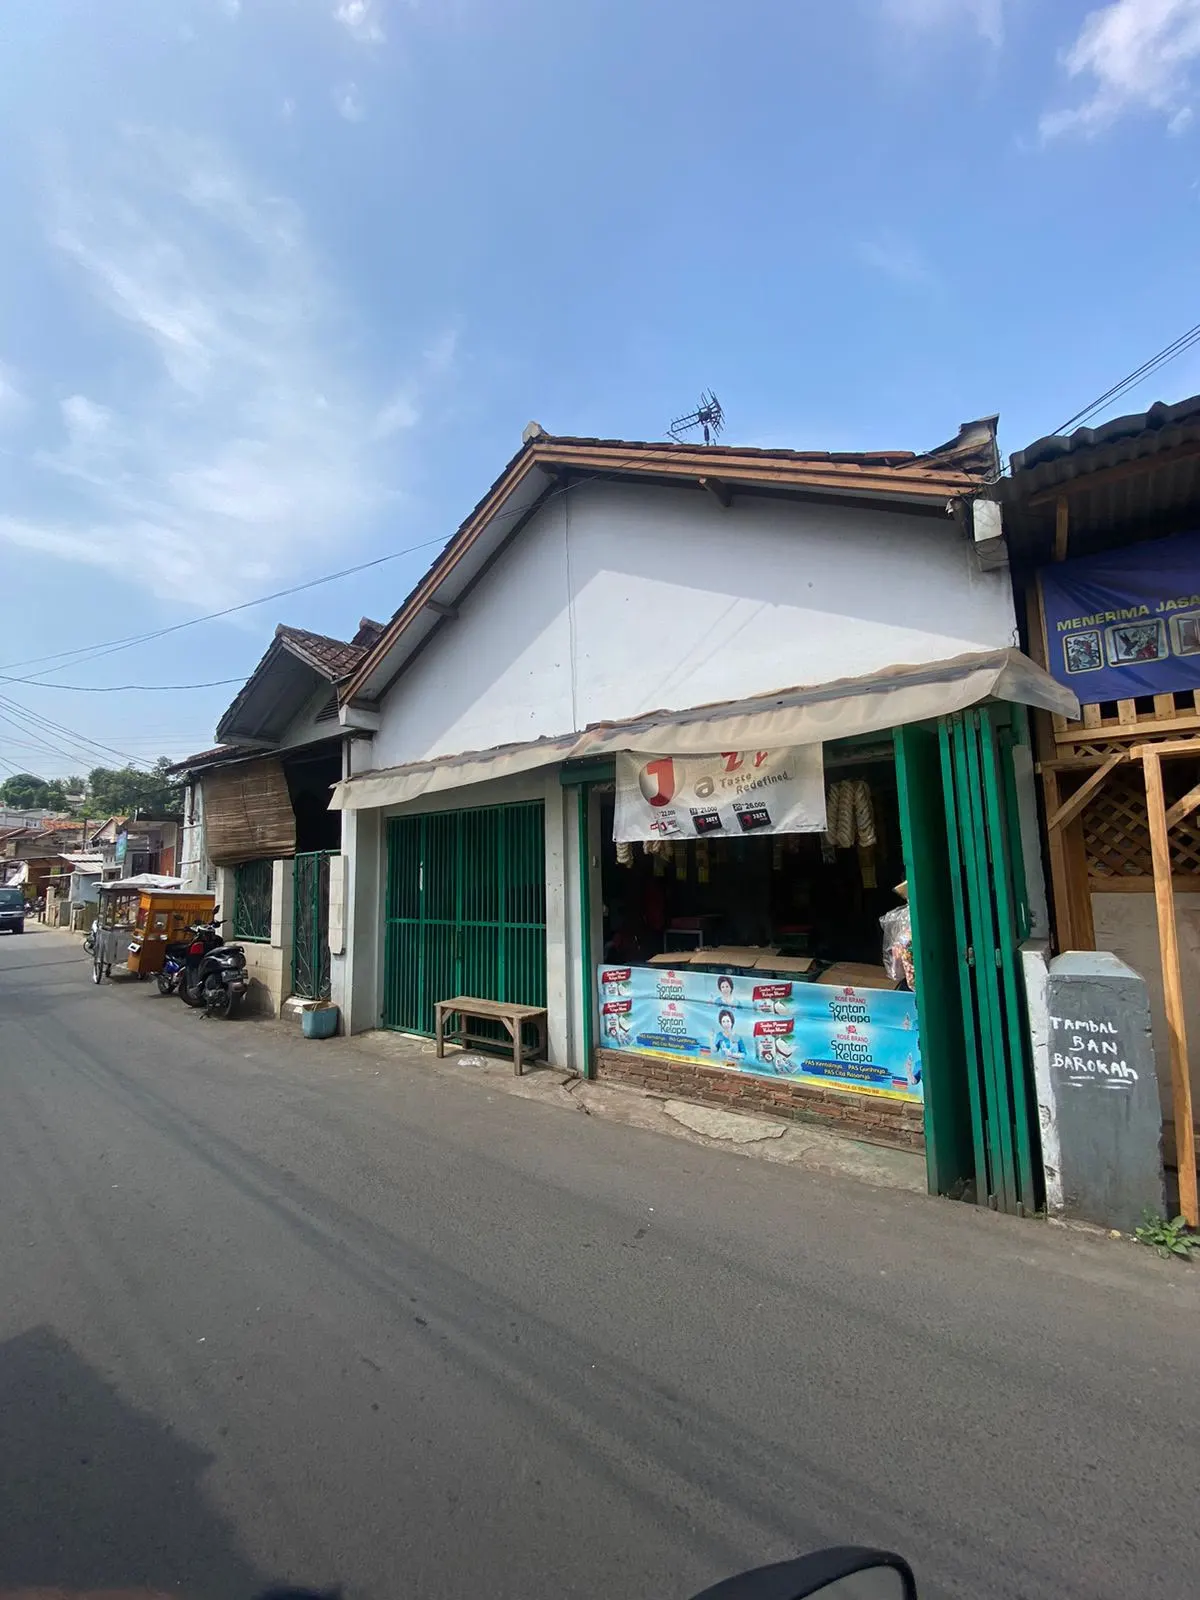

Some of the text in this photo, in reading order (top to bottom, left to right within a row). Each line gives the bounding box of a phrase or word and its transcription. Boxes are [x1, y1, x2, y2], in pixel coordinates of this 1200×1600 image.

[1056, 595, 1200, 632] MENERIMA JASA
[720, 772, 752, 788] Taste
[656, 983, 683, 993] Santan
[829, 1002, 866, 1014] Santan
[657, 1016, 684, 1026] Santan
[834, 1011, 871, 1024] Kelapa
[661, 1024, 687, 1035] Kelapa
[831, 1040, 868, 1053] Santan
[1069, 1035, 1118, 1055] BAN
[836, 1049, 873, 1064] Kelapa
